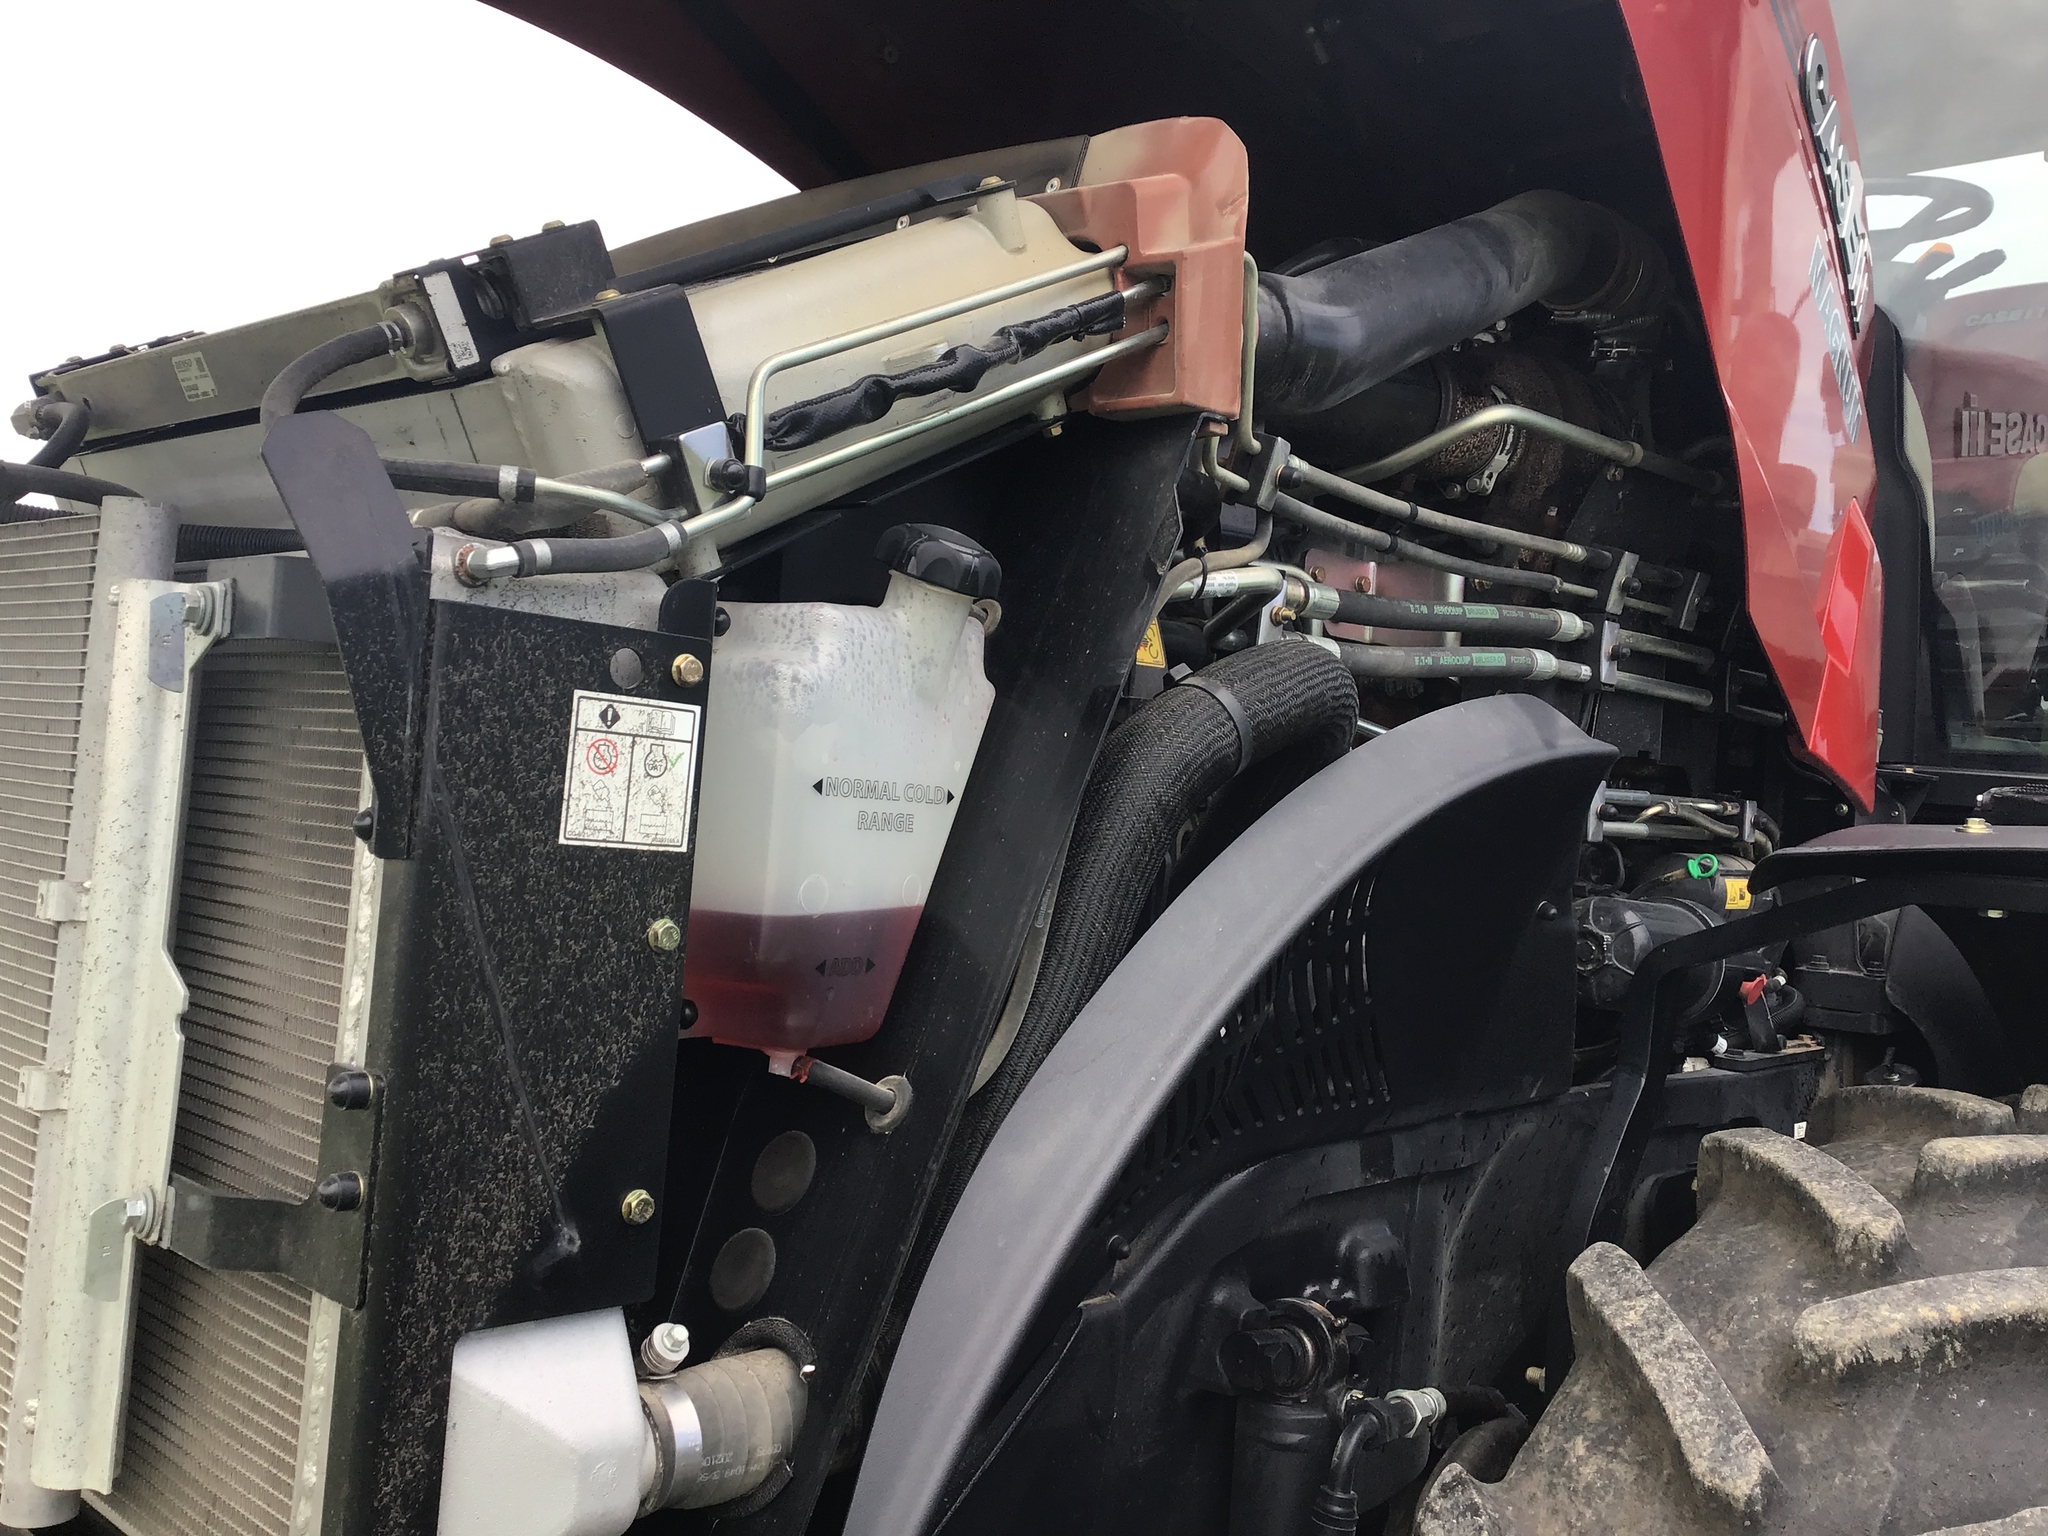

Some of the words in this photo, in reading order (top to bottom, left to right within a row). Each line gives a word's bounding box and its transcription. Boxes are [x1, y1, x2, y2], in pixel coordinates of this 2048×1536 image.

[825, 776, 900, 801] NORMAL
[903, 783, 945, 805] COLD
[857, 810, 914, 833] RANGE
[829, 957, 862, 977] ADD
